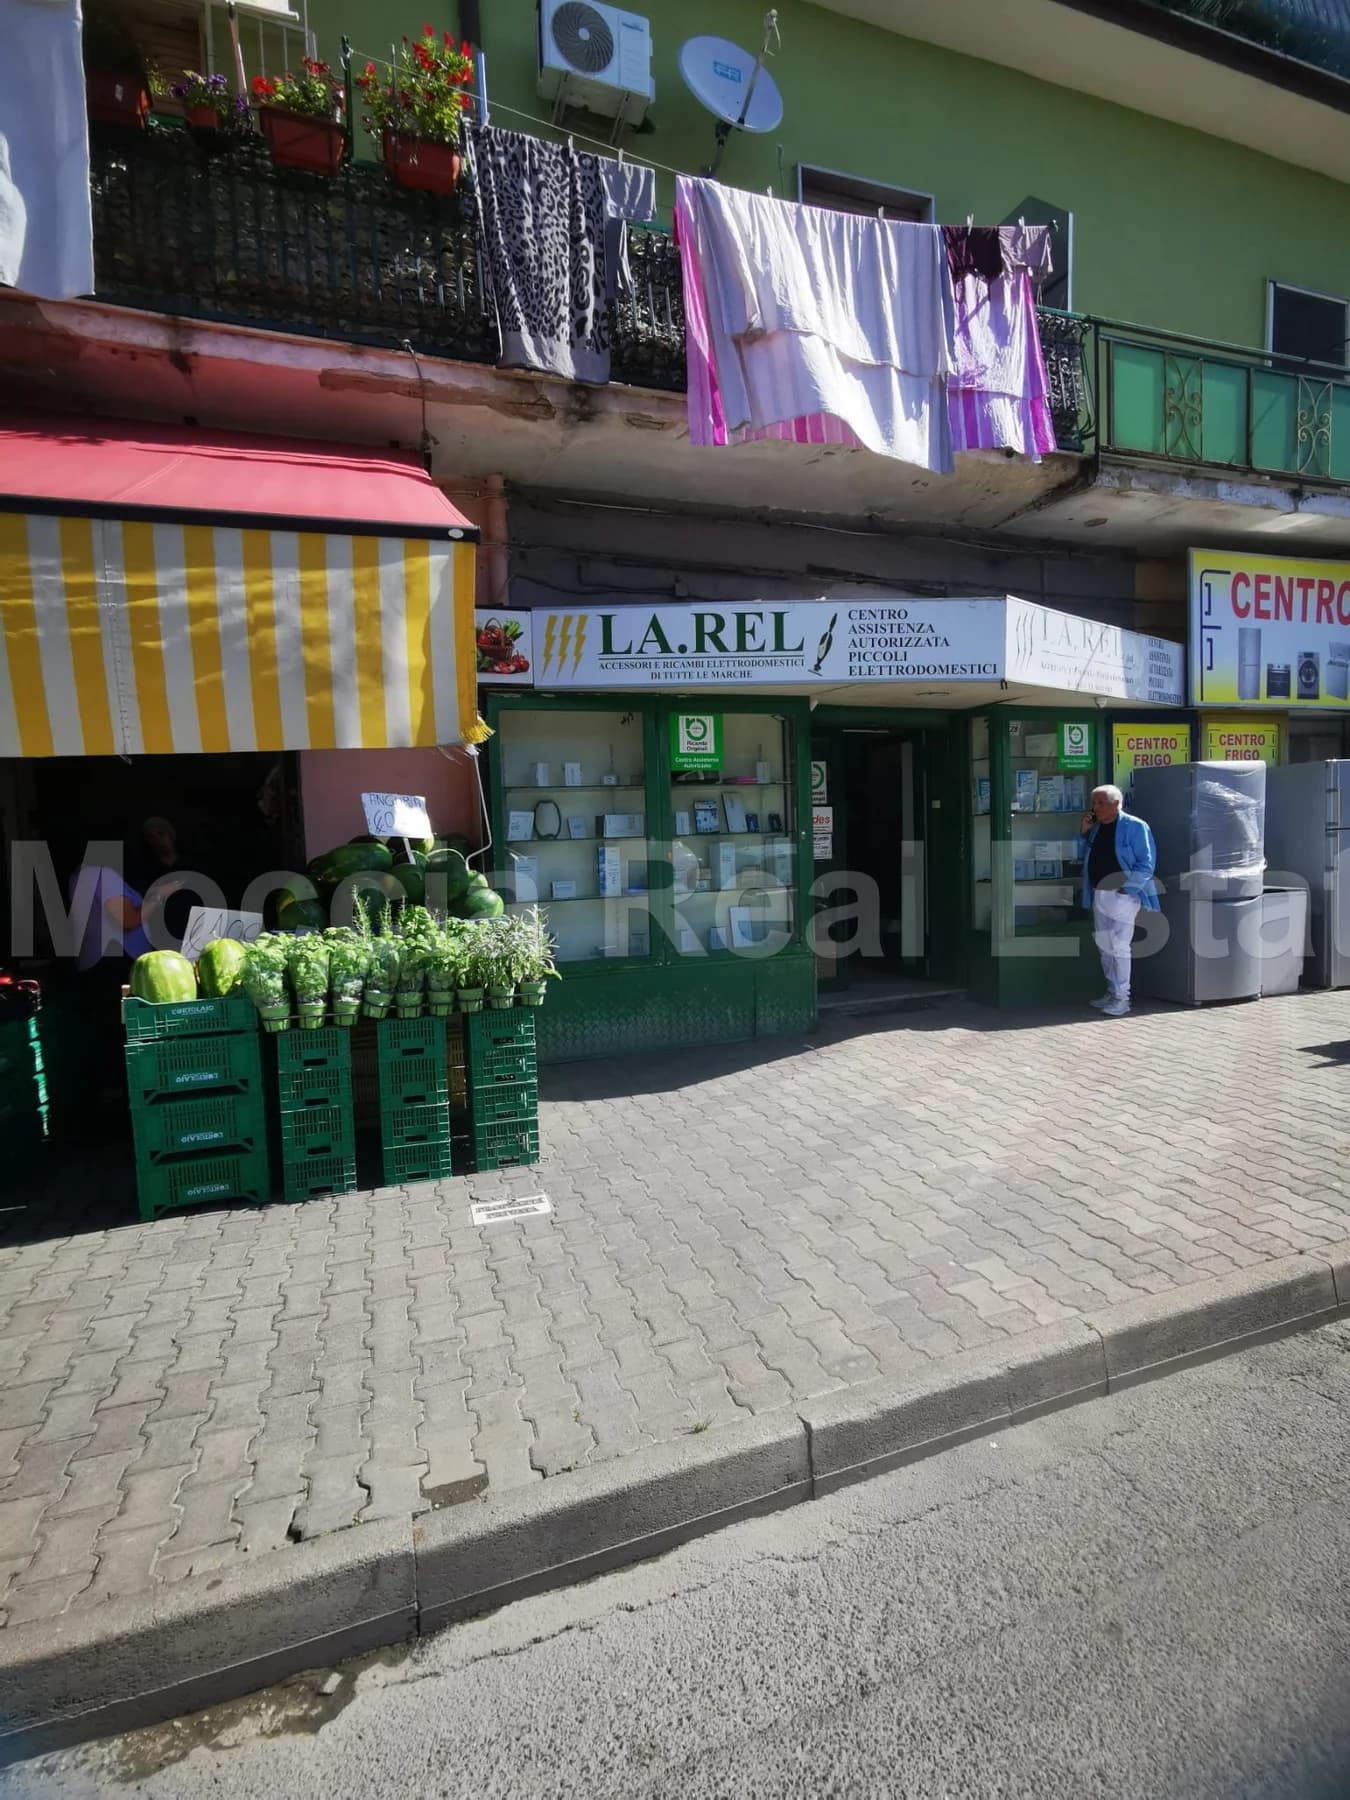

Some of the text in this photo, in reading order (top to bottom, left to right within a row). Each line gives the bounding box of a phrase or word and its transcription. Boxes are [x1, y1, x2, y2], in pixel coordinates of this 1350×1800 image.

[1231, 571, 1350, 626] CENTRO
[847, 608, 909, 621] CENTRO
[597, 611, 805, 656] LA.REL
[847, 622, 936, 635] ASSISTENZA
[847, 636, 950, 649] AUTORIZZATA
[847, 650, 908, 663] PICCOLI
[599, 658, 805, 671] ACCESSORI E RICAMBI ELETTRODOMESTICI
[847, 663, 998, 677] ELETTRODOMESTICI
[650, 669, 753, 681] DI TUTTE LE MARCHE
[1126, 737, 1178, 750] CENTRO
[1219, 733, 1266, 746] CENTRO
[1133, 753, 1172, 766] FRIGO
[1224, 749, 1260, 761] FRIGO
